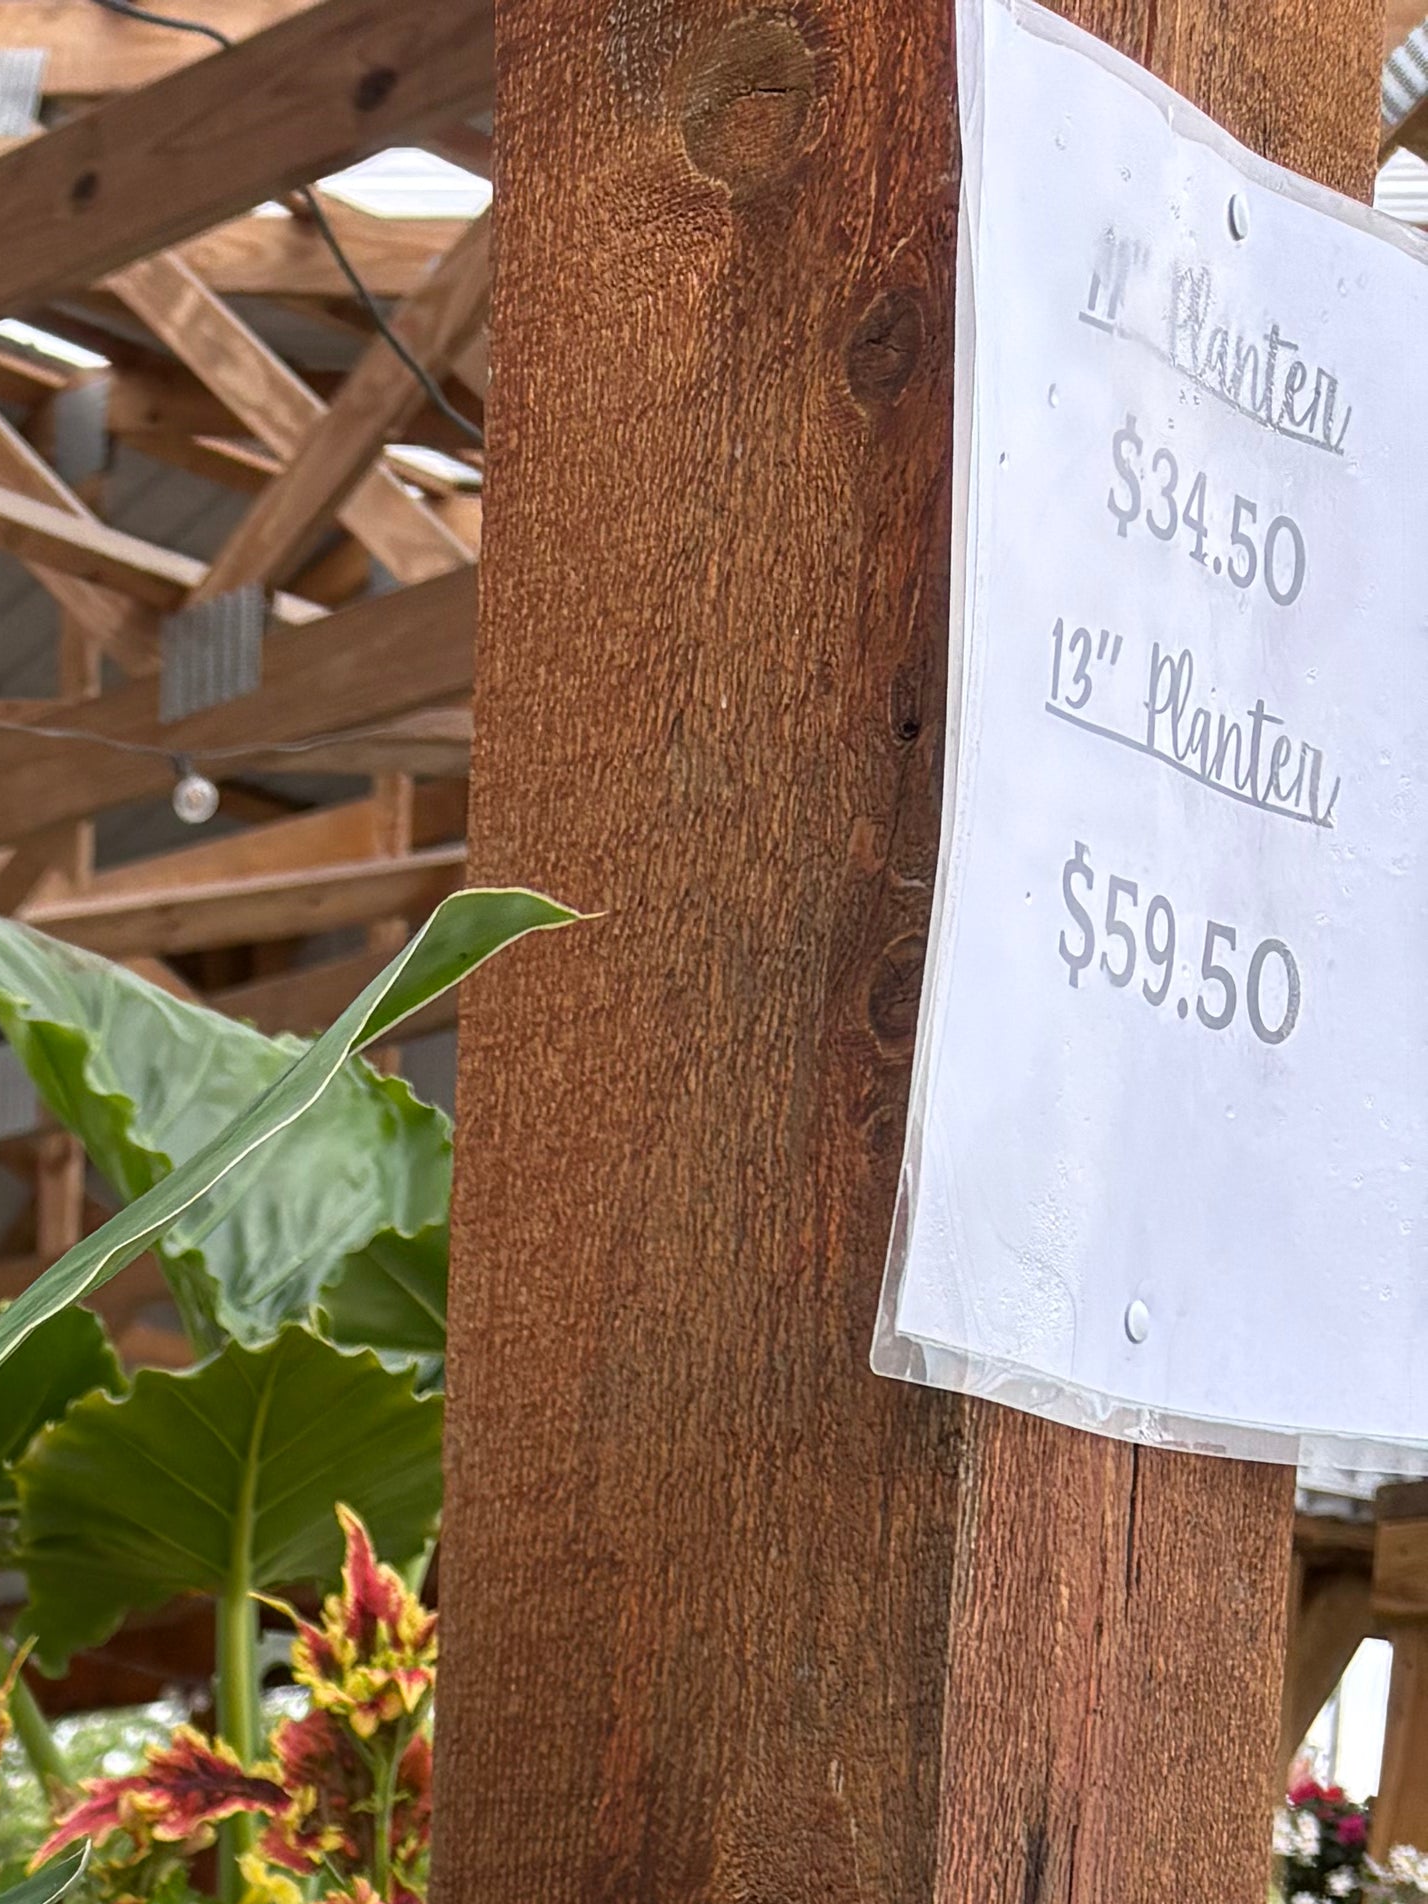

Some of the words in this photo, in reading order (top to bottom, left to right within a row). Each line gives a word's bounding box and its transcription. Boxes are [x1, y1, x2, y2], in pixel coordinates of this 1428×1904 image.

[1168, 262, 1352, 451] Planter
[1107, 412, 1307, 607] $34.50
[1052, 616, 1124, 709] 13"
[1144, 641, 1341, 827] Planter
[1058, 840, 1302, 1045] $59.50
